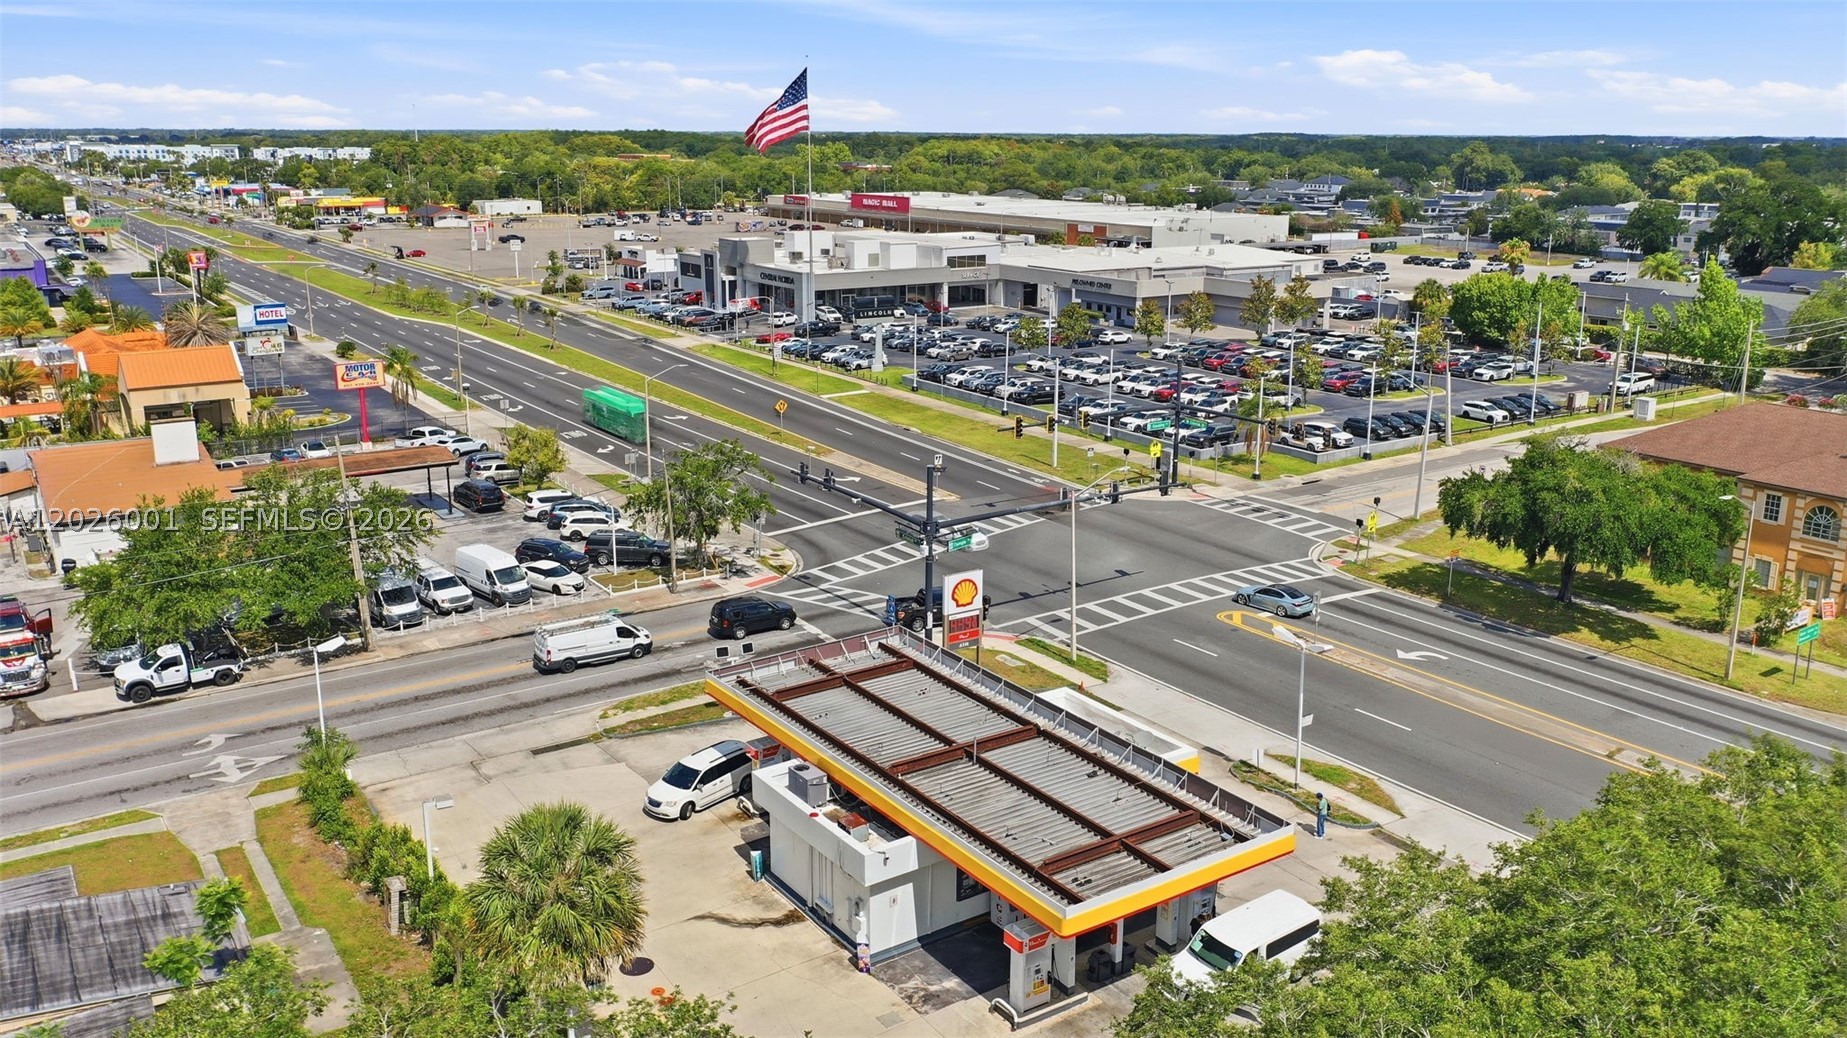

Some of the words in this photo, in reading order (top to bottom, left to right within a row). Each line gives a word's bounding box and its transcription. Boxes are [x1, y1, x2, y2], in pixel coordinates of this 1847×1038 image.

[862, 198, 880, 206] MAGIC
[882, 199, 898, 208] MALL
[258, 310, 284, 318] HOTEL
[345, 363, 376, 372] MOTOR
